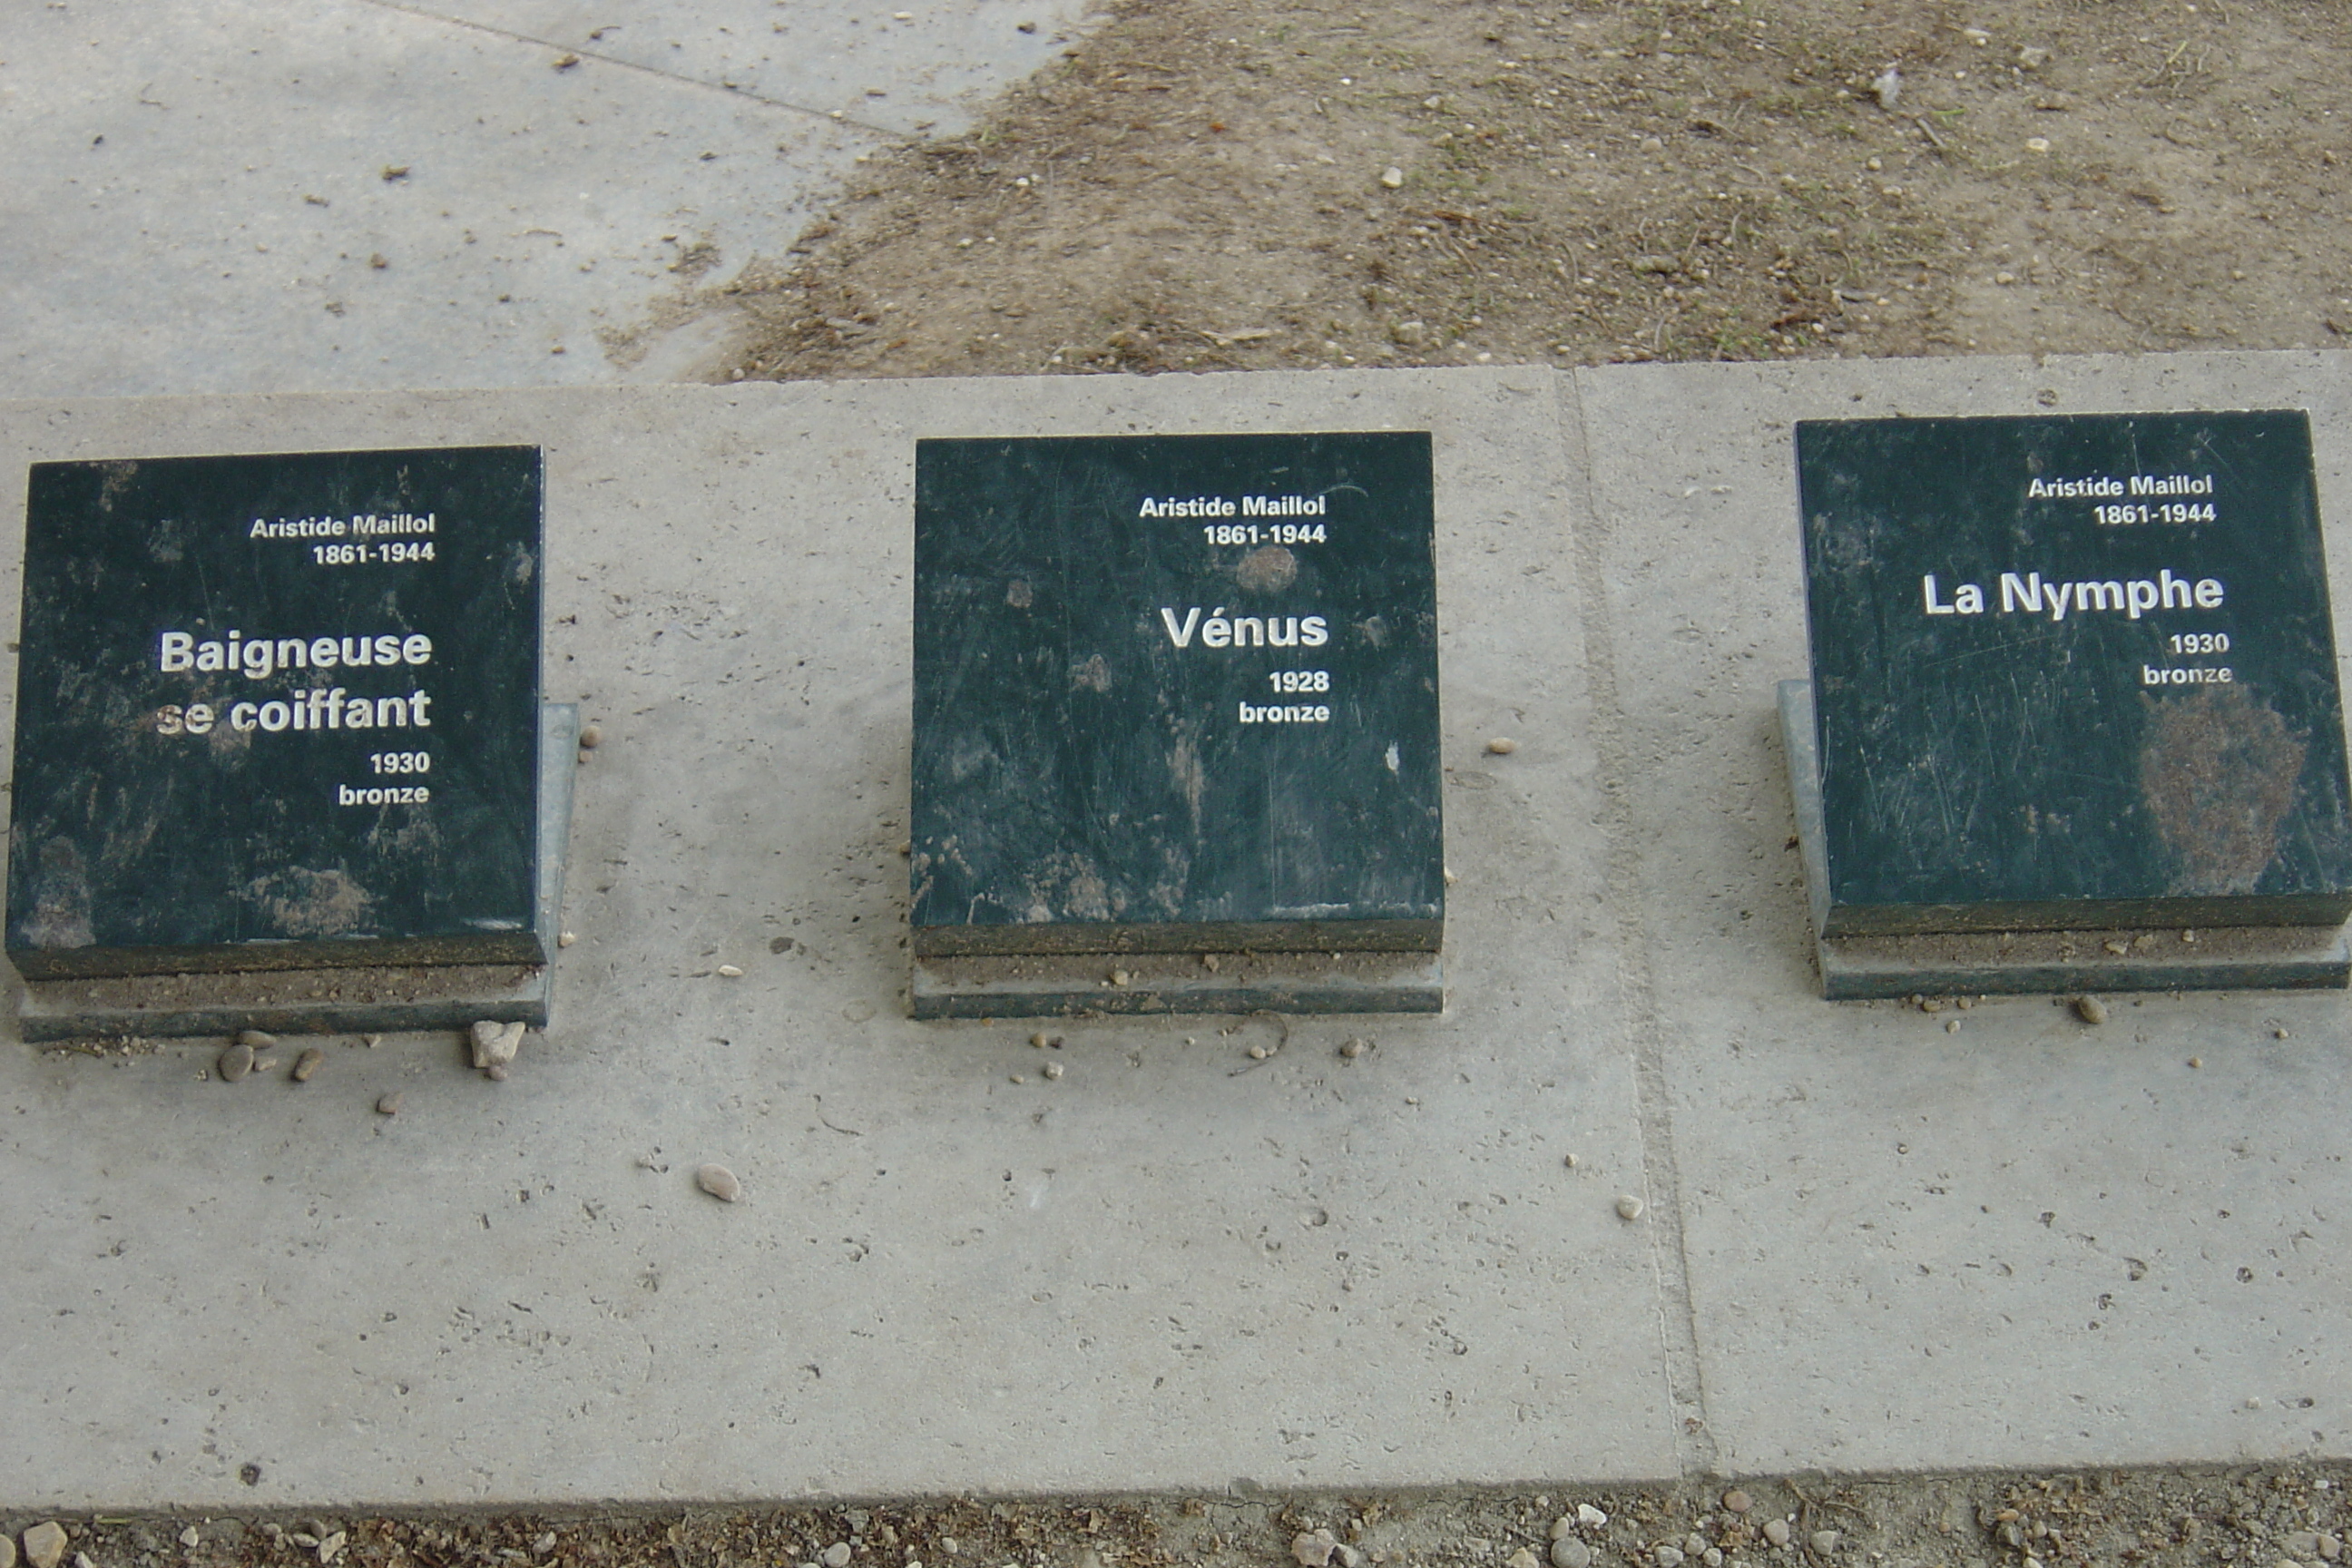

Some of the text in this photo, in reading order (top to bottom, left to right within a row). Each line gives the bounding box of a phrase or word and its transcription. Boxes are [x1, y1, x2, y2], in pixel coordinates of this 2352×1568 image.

[2027, 474, 2213, 498] Aristide Maillol
[1139, 495, 1327, 518] Aristide Maillol
[2093, 503, 2217, 524] 1861-1944
[250, 513, 436, 538] Aristide Maillol
[1203, 524, 1328, 545] 1861-1944
[313, 542, 436, 564] 1861-1944
[1924, 569, 2225, 621] La Nymphe
[1161, 606, 1329, 648] Vénus
[2170, 632, 2230, 654] 1930
[160, 631, 432, 679] Baigneuse
[1269, 671, 1330, 693] 1928
[2142, 664, 2232, 685] bronze
[156, 687, 431, 735] se coiffant
[1239, 701, 1330, 723] bronze
[370, 751, 430, 774] 1930
[338, 784, 430, 806] bronze
